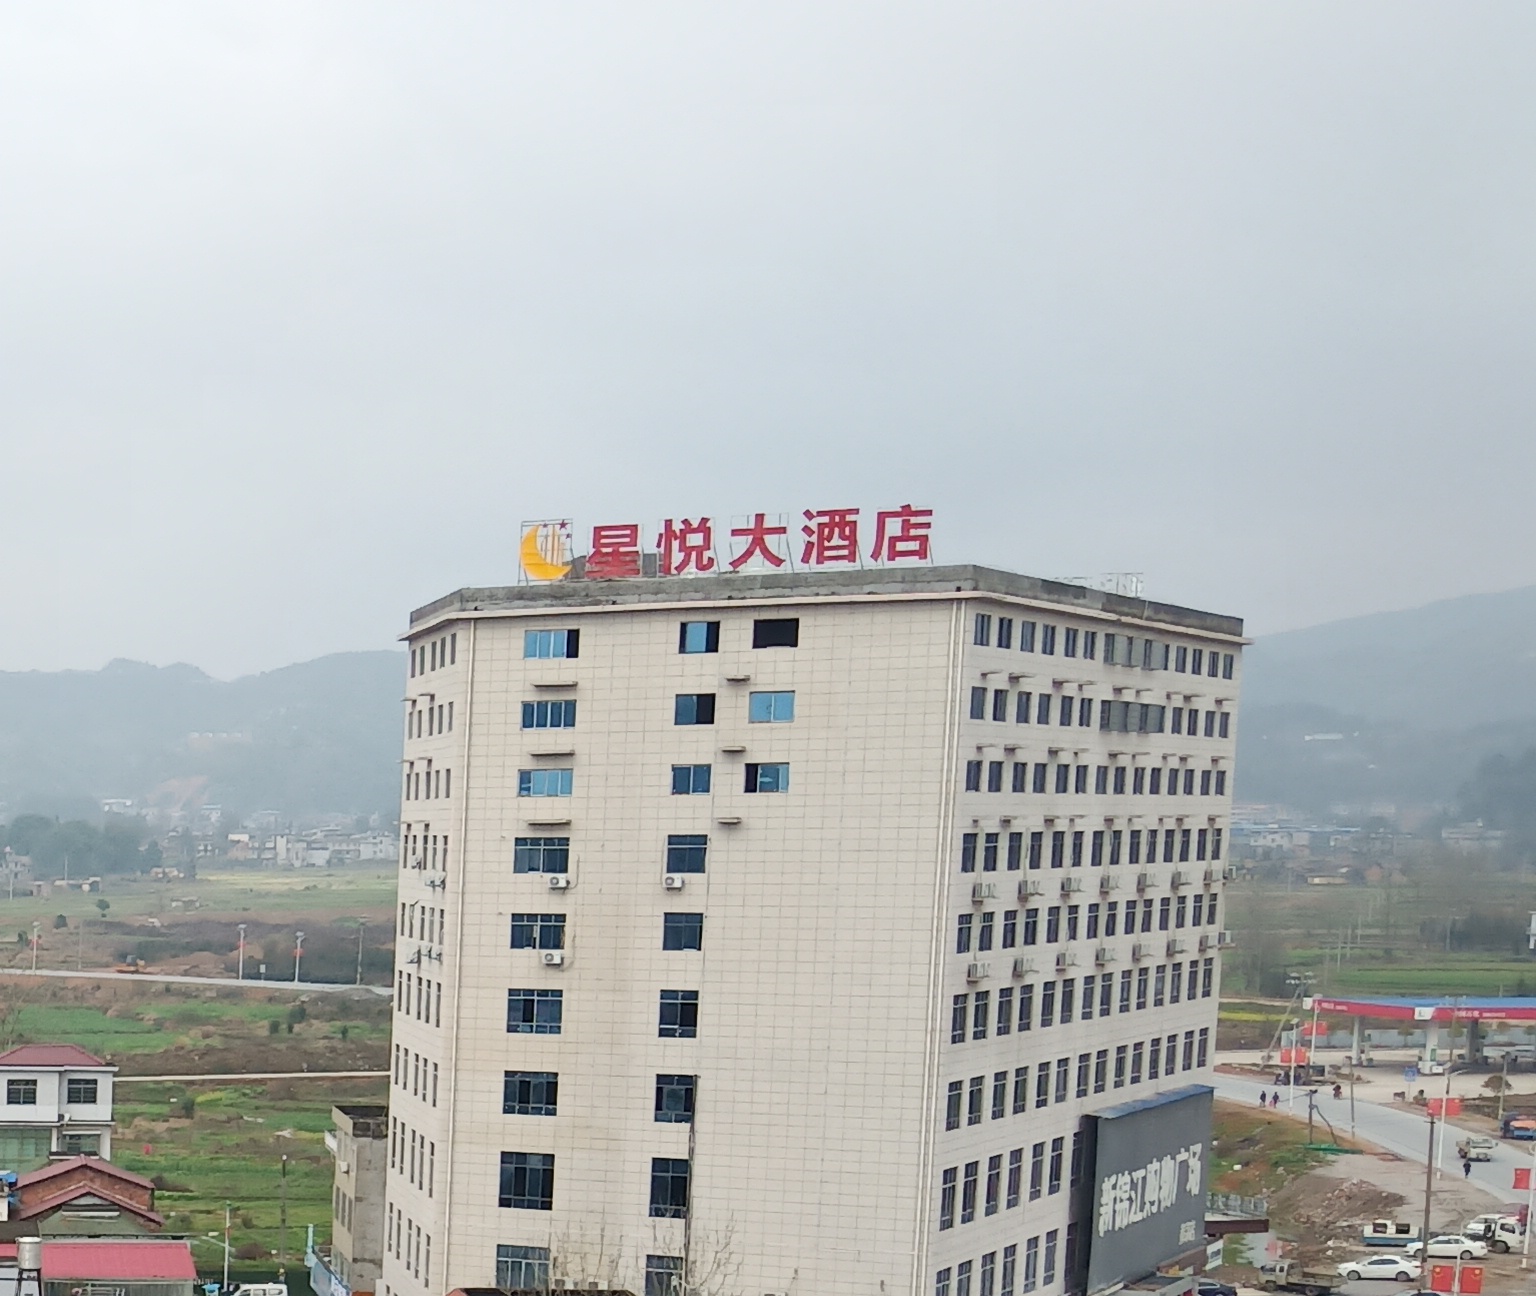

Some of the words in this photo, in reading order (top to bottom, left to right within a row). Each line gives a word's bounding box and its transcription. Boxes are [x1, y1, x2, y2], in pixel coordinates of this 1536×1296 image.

[585, 504, 933, 579] 星悦大酒店
